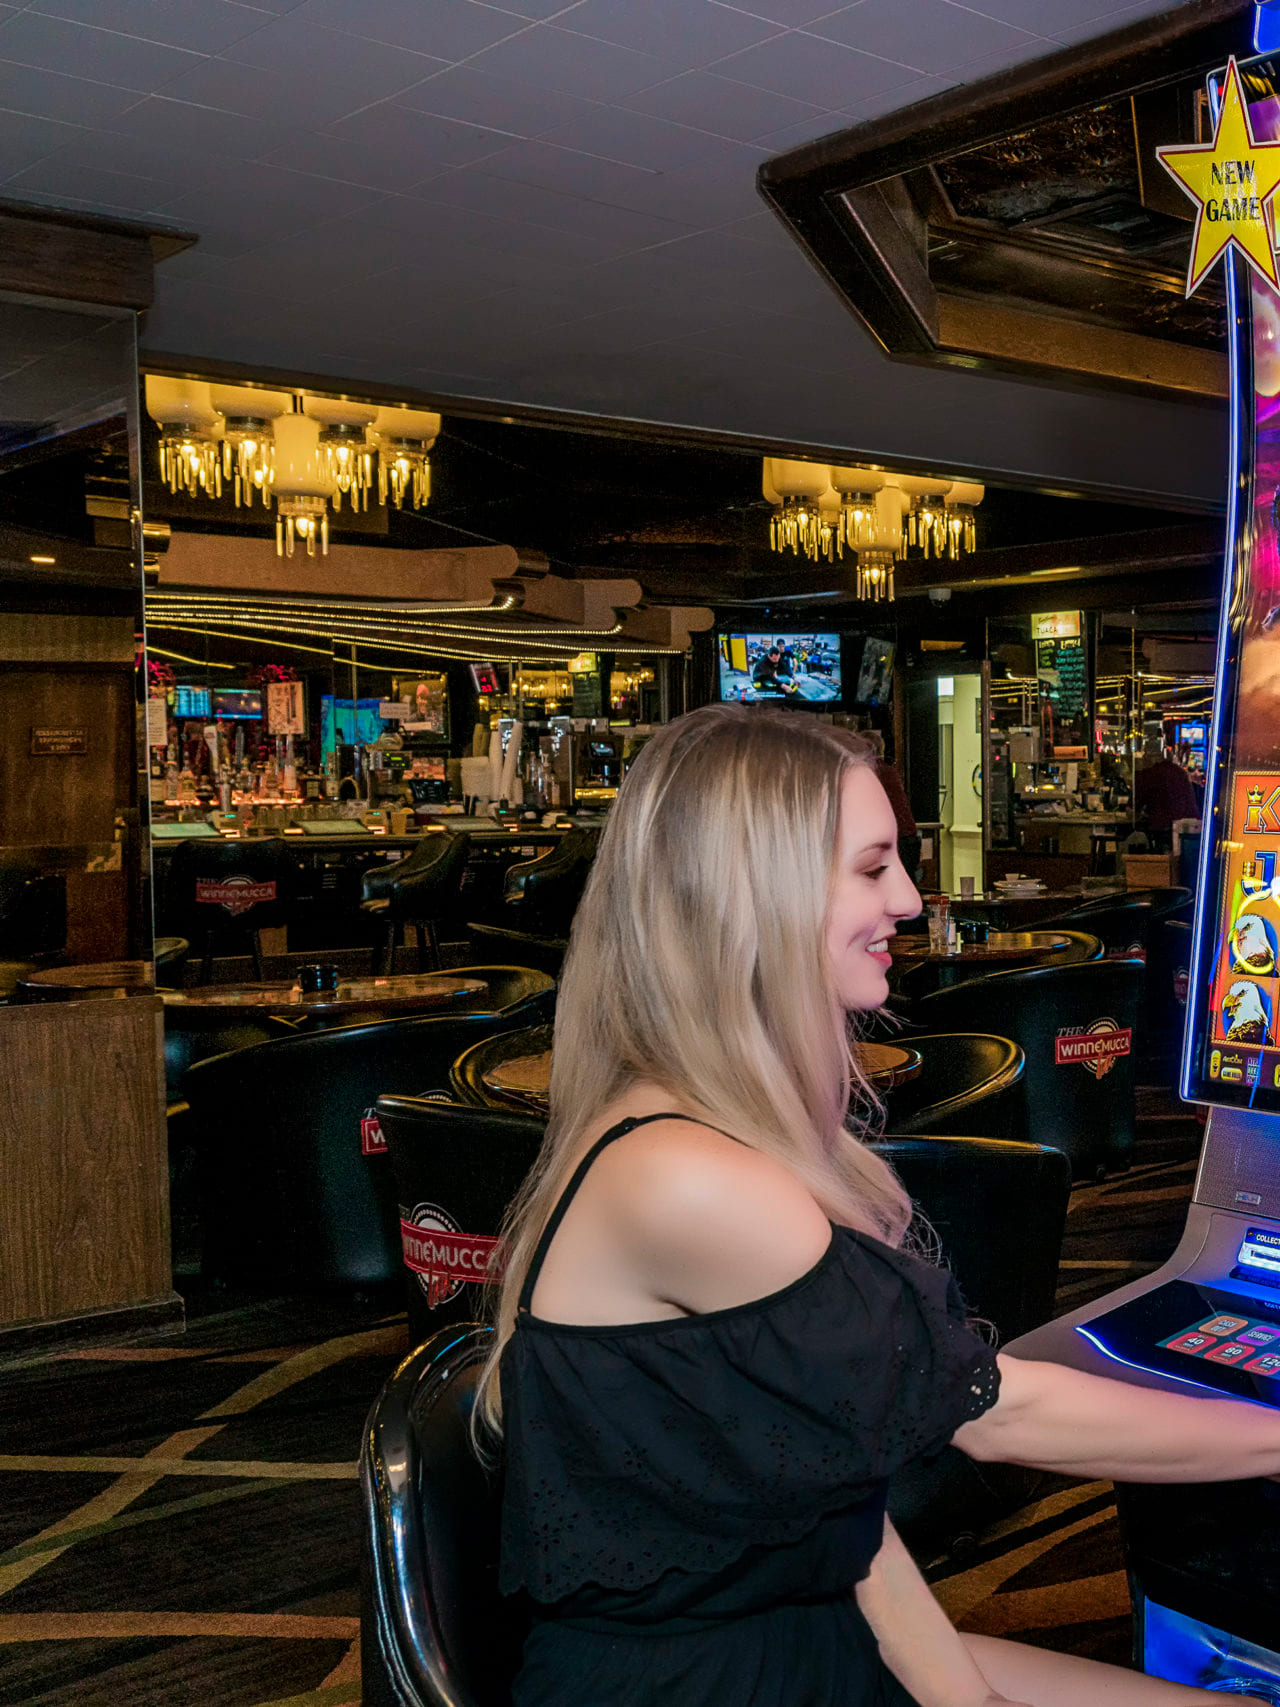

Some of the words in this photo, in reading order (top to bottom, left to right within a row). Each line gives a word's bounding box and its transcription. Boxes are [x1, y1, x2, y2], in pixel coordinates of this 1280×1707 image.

[1210, 160, 1255, 185] NEW
[1206, 197, 1261, 222] GAME
[1187, 1337, 1204, 1345] 40
[1224, 1347, 1242, 1355] 80
